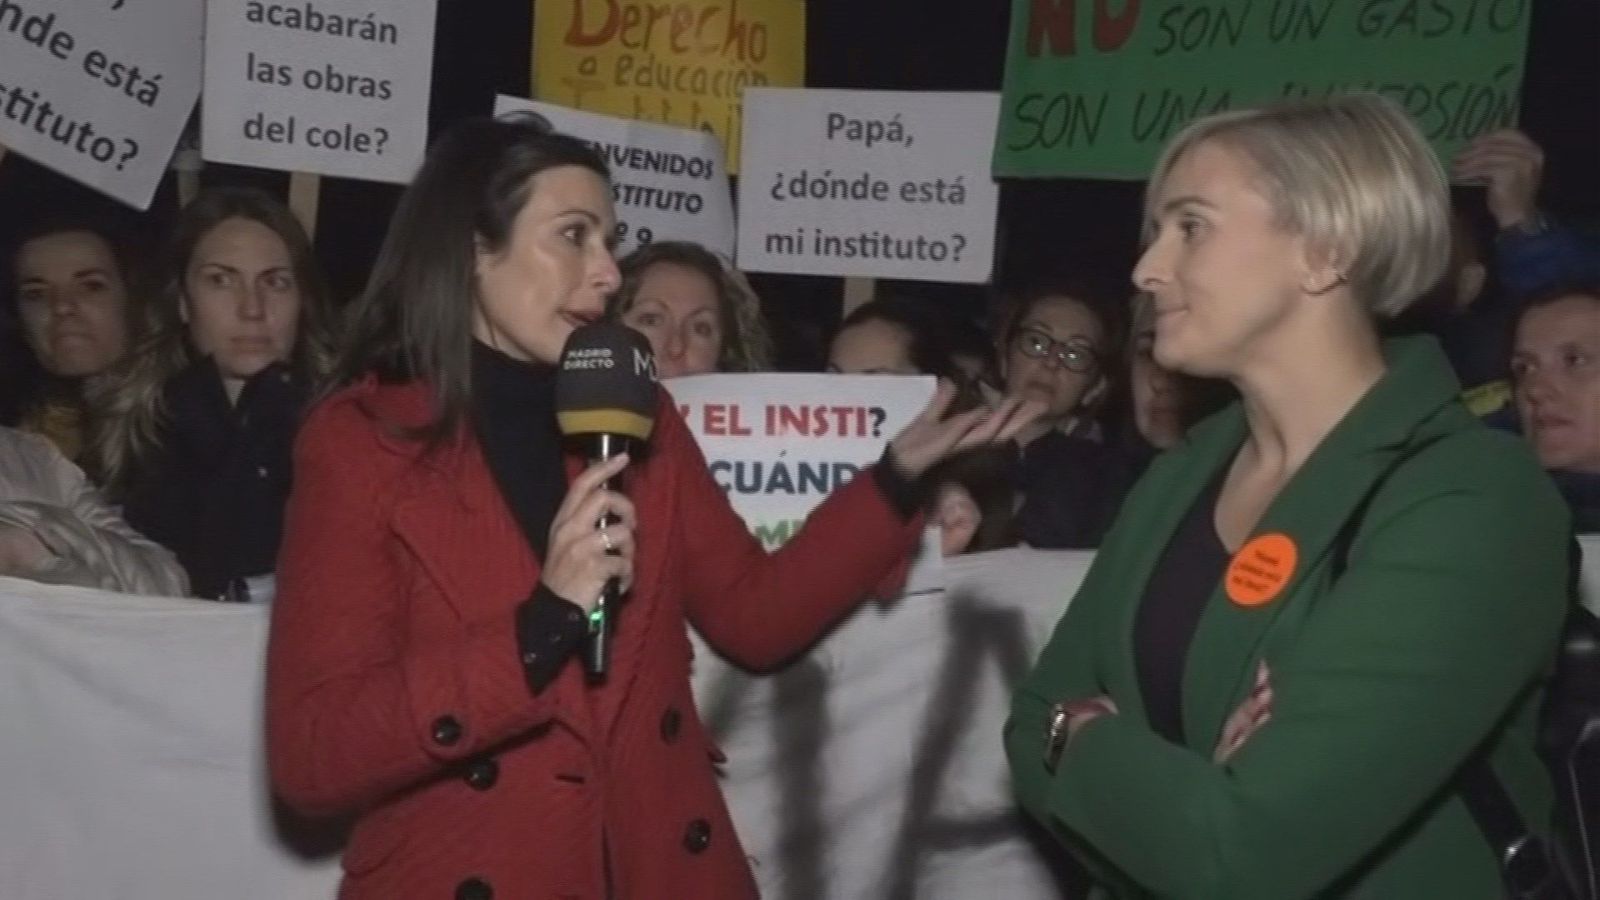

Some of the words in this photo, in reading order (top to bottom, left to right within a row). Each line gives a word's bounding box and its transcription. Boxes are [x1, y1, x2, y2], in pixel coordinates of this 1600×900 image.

[247, 1, 398, 45] acabarán
[1154, 3, 1250, 56] SON
[1269, 0, 1333, 43] UN
[83, 50, 163, 108] está
[247, 52, 293, 87] las
[303, 64, 393, 101] obras
[0, 83, 139, 171] tituto?
[243, 113, 295, 144] del
[305, 124, 389, 155] cole?
[827, 112, 914, 148] Papá,
[1008, 91, 1109, 151] SON
[586, 140, 714, 180] NVENIDOS
[771, 169, 889, 201] ¿dónde
[900, 175, 966, 205] está
[765, 228, 804, 255] mi
[814, 228, 966, 262] instituto?
[564, 358, 615, 370] DIRECTO
[704, 404, 751, 436] EL
[766, 405, 887, 438] INSTI?
